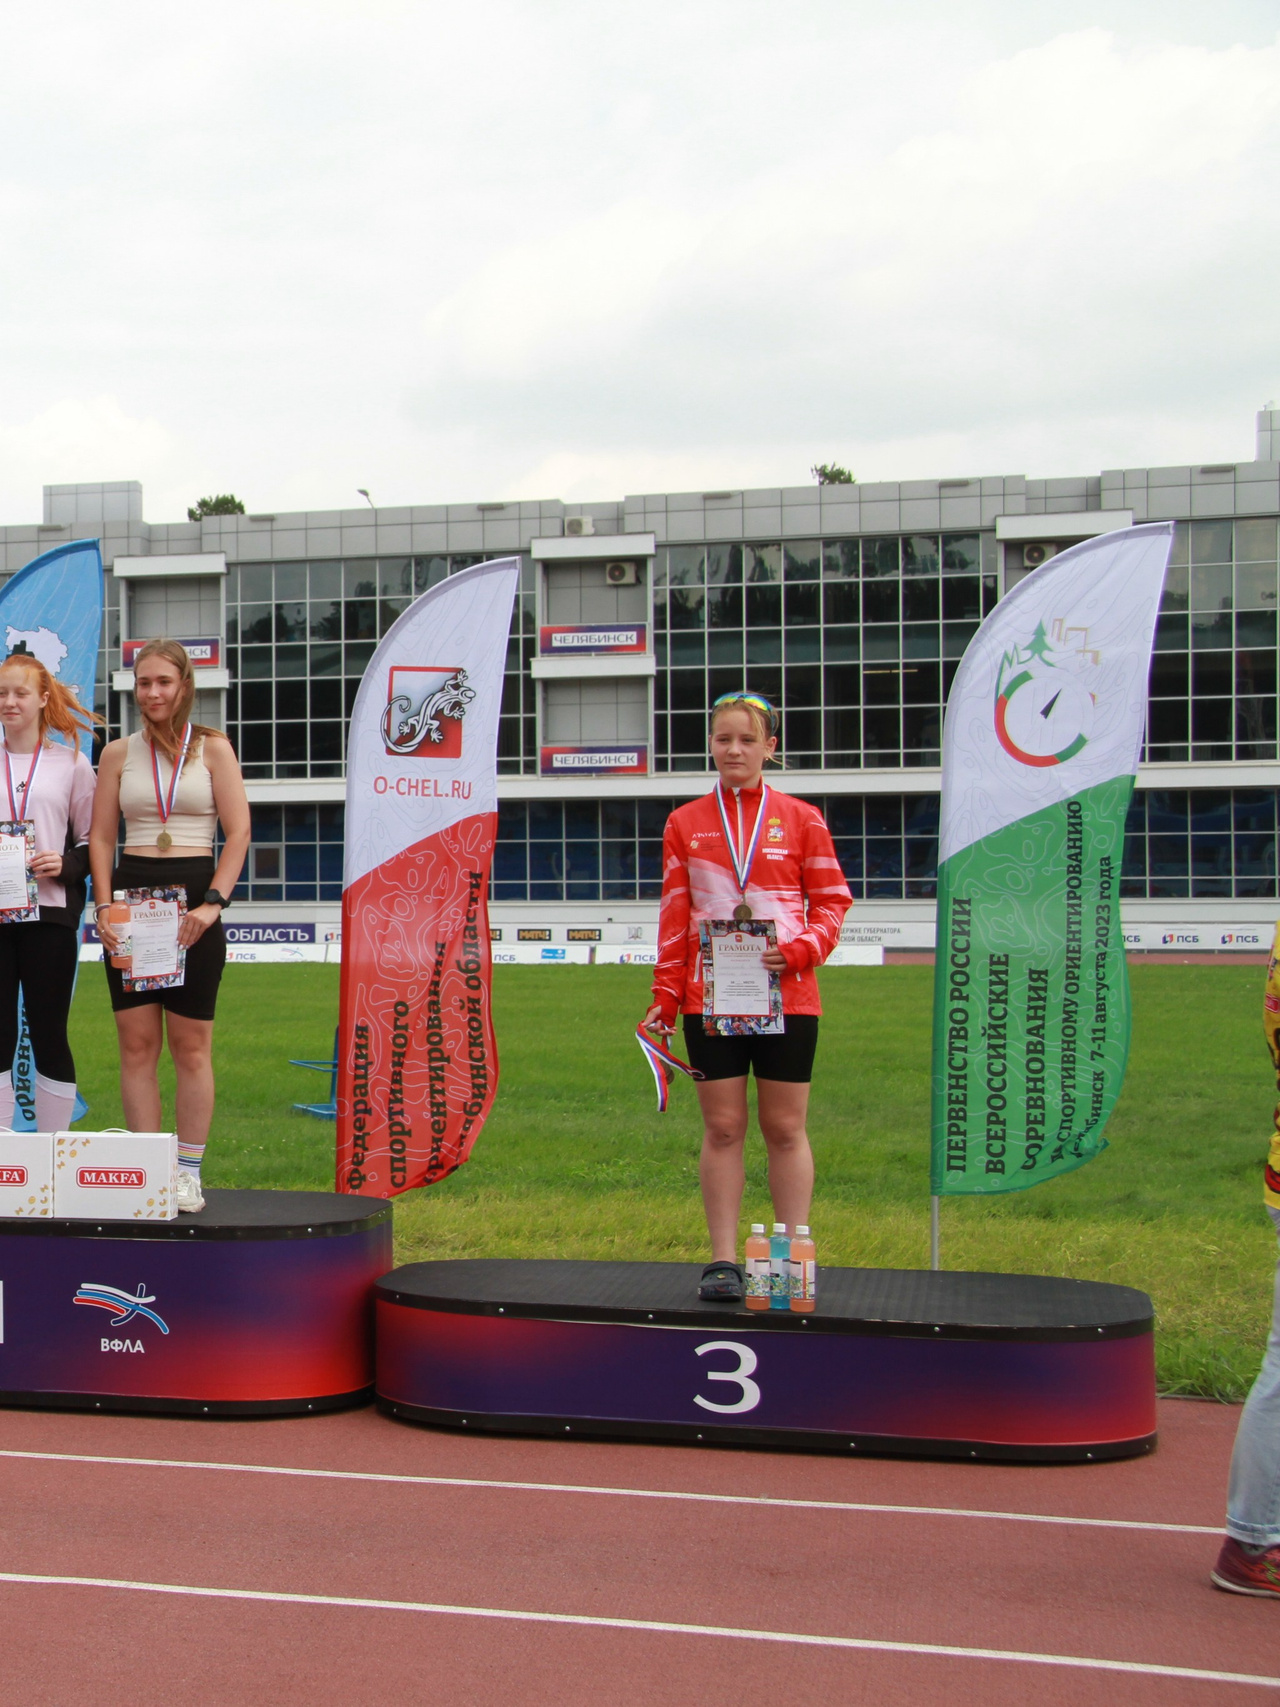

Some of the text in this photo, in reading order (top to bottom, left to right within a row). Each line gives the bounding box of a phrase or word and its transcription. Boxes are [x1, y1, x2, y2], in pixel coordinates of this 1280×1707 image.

[554, 633, 635, 645] ЧЕЛЯБИНСК
[554, 755, 635, 765] ЧЕЛЯБИНСК
[373, 775, 472, 800] O-CHEL.RU
[1099, 855, 1115, 901] года
[133, 909, 173, 920] ГРАМОТА
[1064, 800, 1083, 995] ОРИЕНТИРОВАНИЮ
[225, 928, 310, 942] ОБЛАСТЬ
[455, 870, 484, 992] области
[1095, 903, 1111, 949] 2023
[1176, 935, 1199, 943] ПСБ
[1235, 935, 1259, 943] ПСБ
[494, 954, 516, 962] ПСБ
[634, 954, 656, 962] ПСБ
[718, 944, 762, 952] ГРАМОТА
[1095, 951, 1111, 1024] августа
[946, 897, 972, 1173] ПЕРВЕНСТВО РОССИИ
[1090, 1026, 1107, 1062] 7-11
[981, 953, 1010, 1175] ВСЕРОССИЙСКИЕ
[1020, 967, 1049, 1171] СОРЕВНОВАНИЯ
[1056, 997, 1080, 1143] СПОРТИВНОМУ
[347, 1023, 373, 1190] Федерация
[388, 1000, 412, 1188] спортивного
[82, 1171, 139, 1186] MAKFA
[100, 1337, 146, 1354] ВФЛА
[692, 1340, 761, 1414] 3
